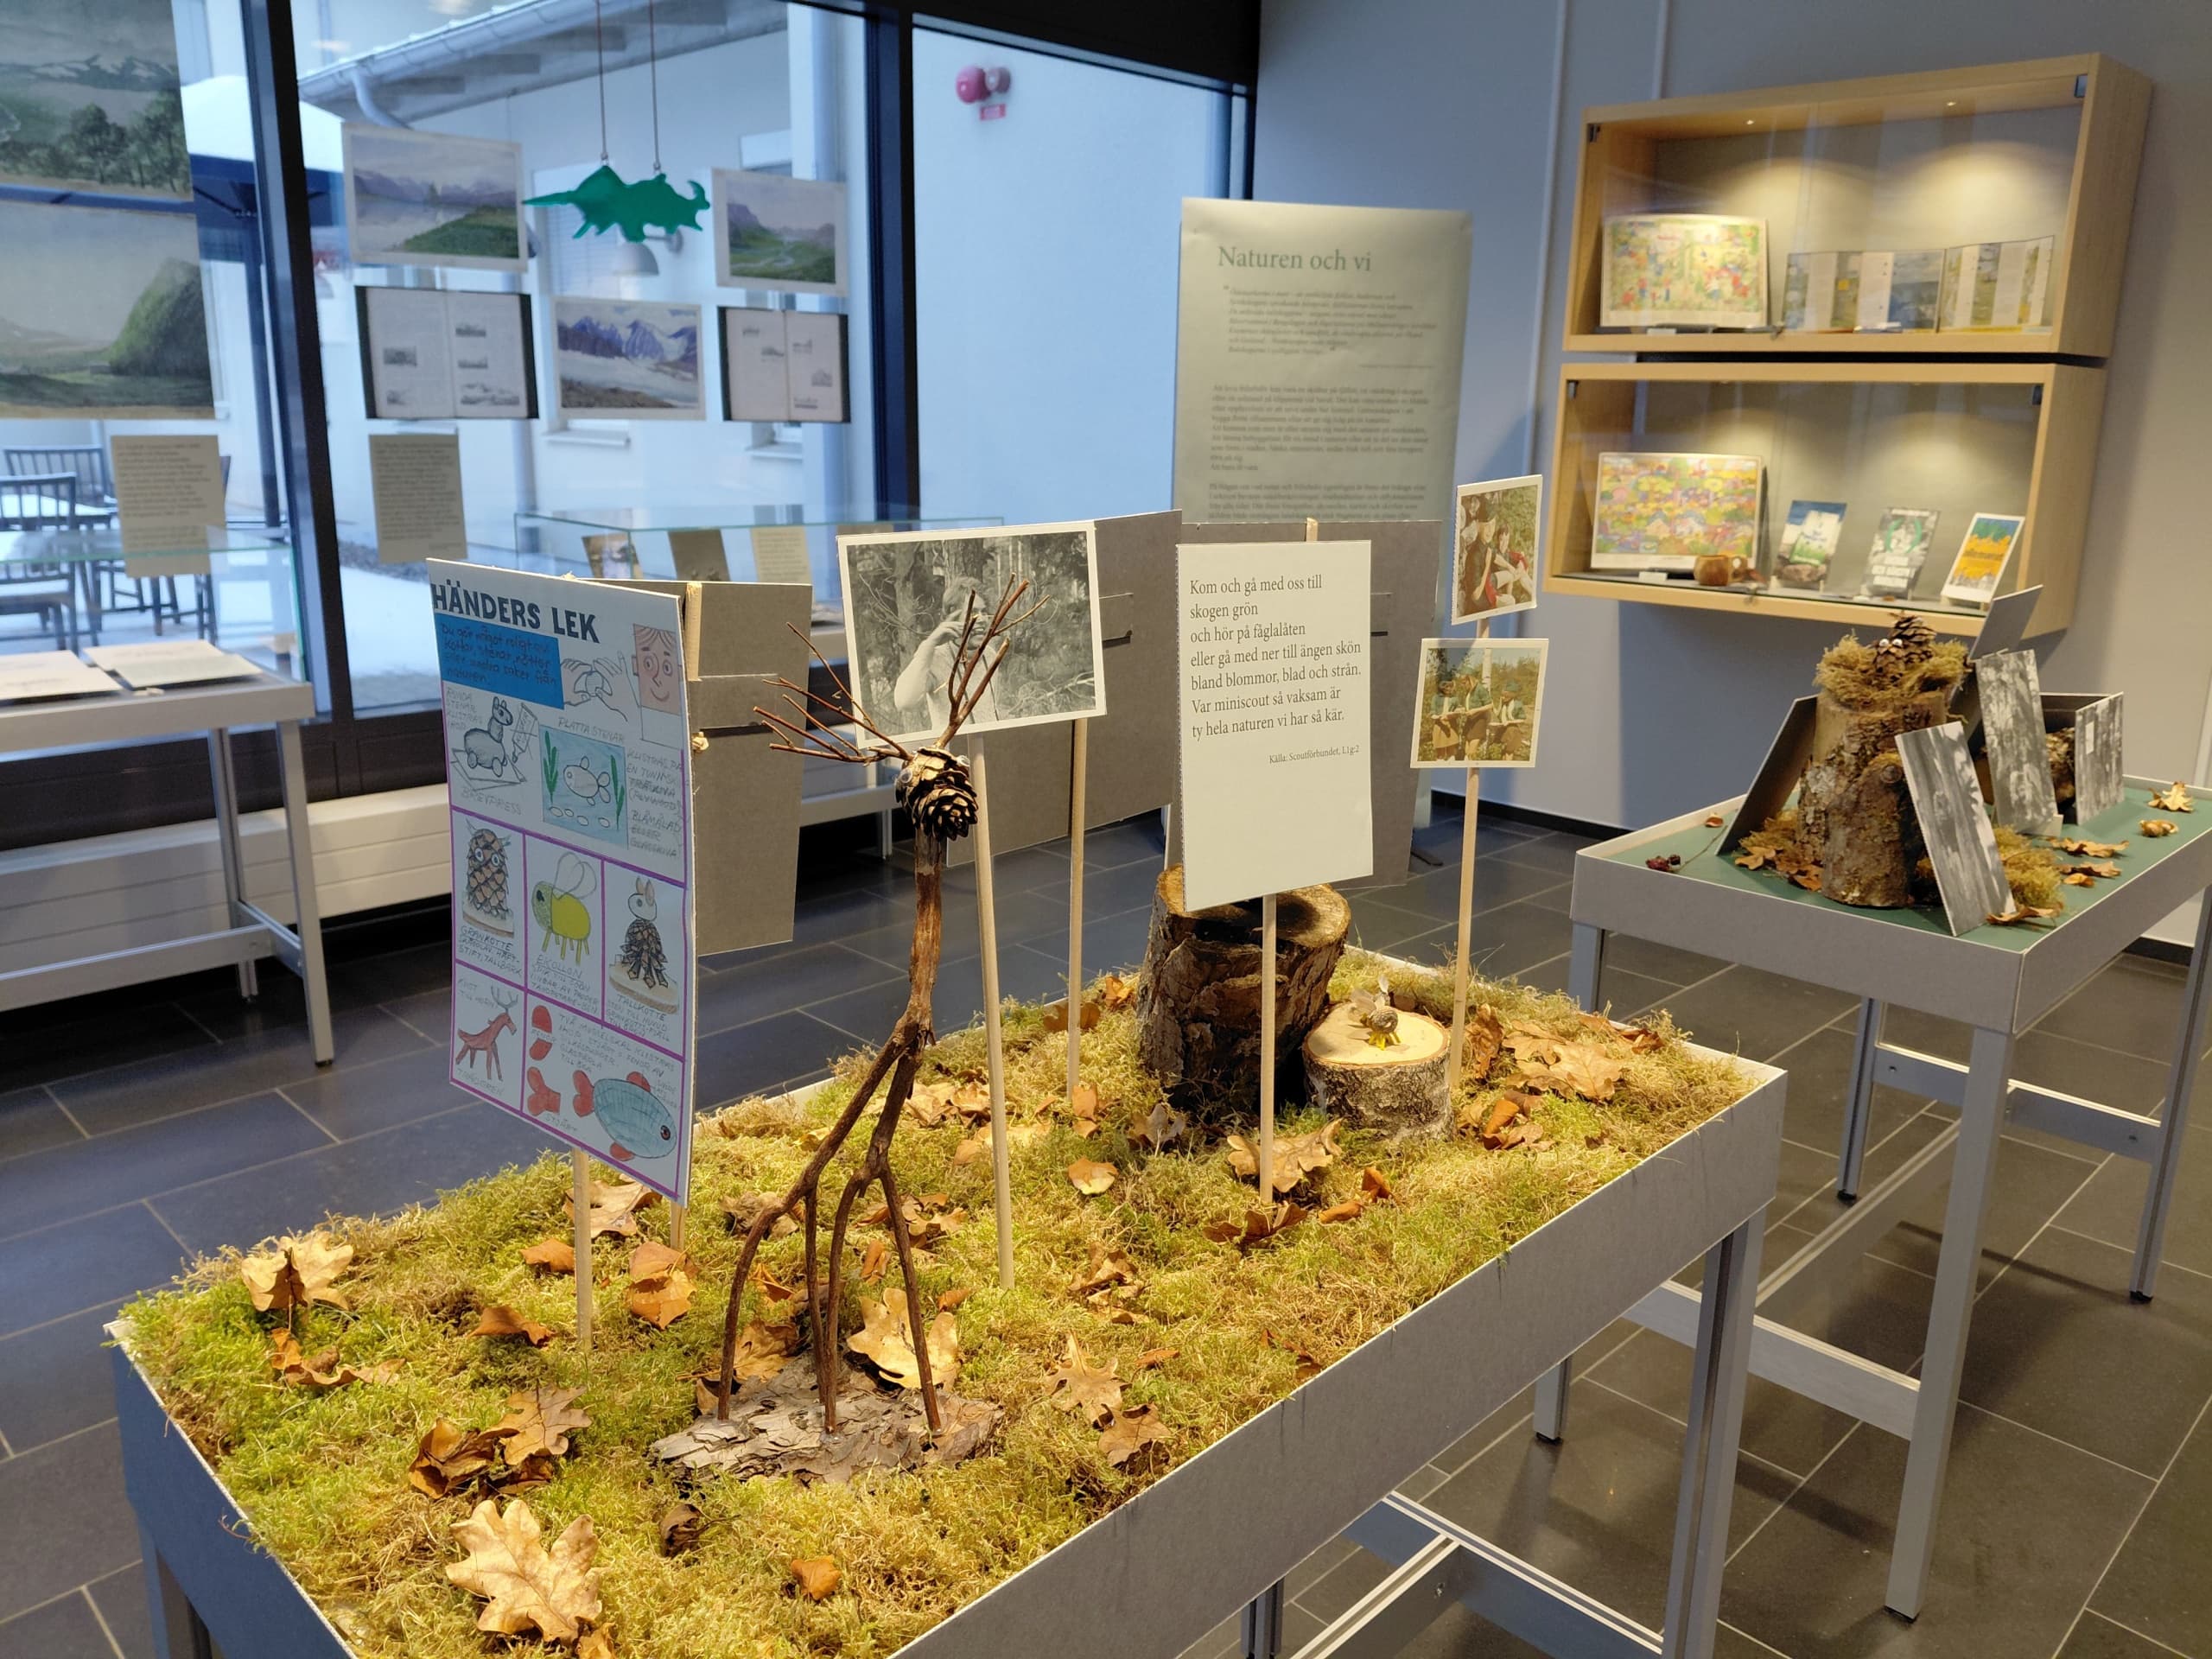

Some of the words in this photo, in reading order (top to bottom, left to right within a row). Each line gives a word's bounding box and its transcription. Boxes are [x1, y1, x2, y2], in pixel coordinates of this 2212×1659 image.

[1217, 246, 1303, 270] Naturen
[1310, 249, 1346, 270] och
[1353, 251, 1372, 271] vi
[1190, 579, 1217, 594] Kom
[1220, 577, 1241, 594] och
[1244, 577, 1257, 596] gå
[1260, 575, 1284, 591] med
[1287, 577, 1305, 590] oss
[1307, 574, 1322, 589] till
[430, 578, 541, 630] HÄNDERS
[551, 607, 601, 644] LEK
[1190, 602, 1229, 622] skogen
[1232, 602, 1258, 620] grön
[1190, 626, 1211, 643] och
[1214, 626, 1234, 641] hör
[1236, 625, 1250, 644] på
[1253, 622, 1306, 643] fåglalåten
[1190, 651, 1215, 667] eller
[1218, 650, 1230, 669] gå
[1234, 647, 1259, 664] med
[1262, 647, 1280, 661] ner
[1282, 644, 1298, 659] till
[1300, 643, 1332, 661] ängen
[1336, 640, 1361, 655] skön
[1191, 673, 1223, 690] bland
[1225, 671, 1280, 688] blommor,
[1282, 666, 1306, 683] blad
[1308, 664, 1328, 679] och
[1332, 662, 1362, 677] strån.
[1191, 698, 1211, 714] Var
[1214, 693, 1269, 712] miniscout
[1272, 690, 1284, 705] så
[1286, 688, 1327, 703] vaksam
[1330, 686, 1342, 700] är
[1192, 724, 1204, 741] ty
[1205, 719, 1229, 736] hela
[1231, 717, 1274, 733] naturen
[1277, 713, 1287, 727] vi
[1290, 711, 1308, 726] har
[1311, 708, 1322, 723] så
[1325, 708, 1344, 721] kär.
[1268, 753, 1287, 765] Källa:
[536, 954, 582, 980] EKOLLON
[616, 995, 667, 1022] TALLKOTTE
